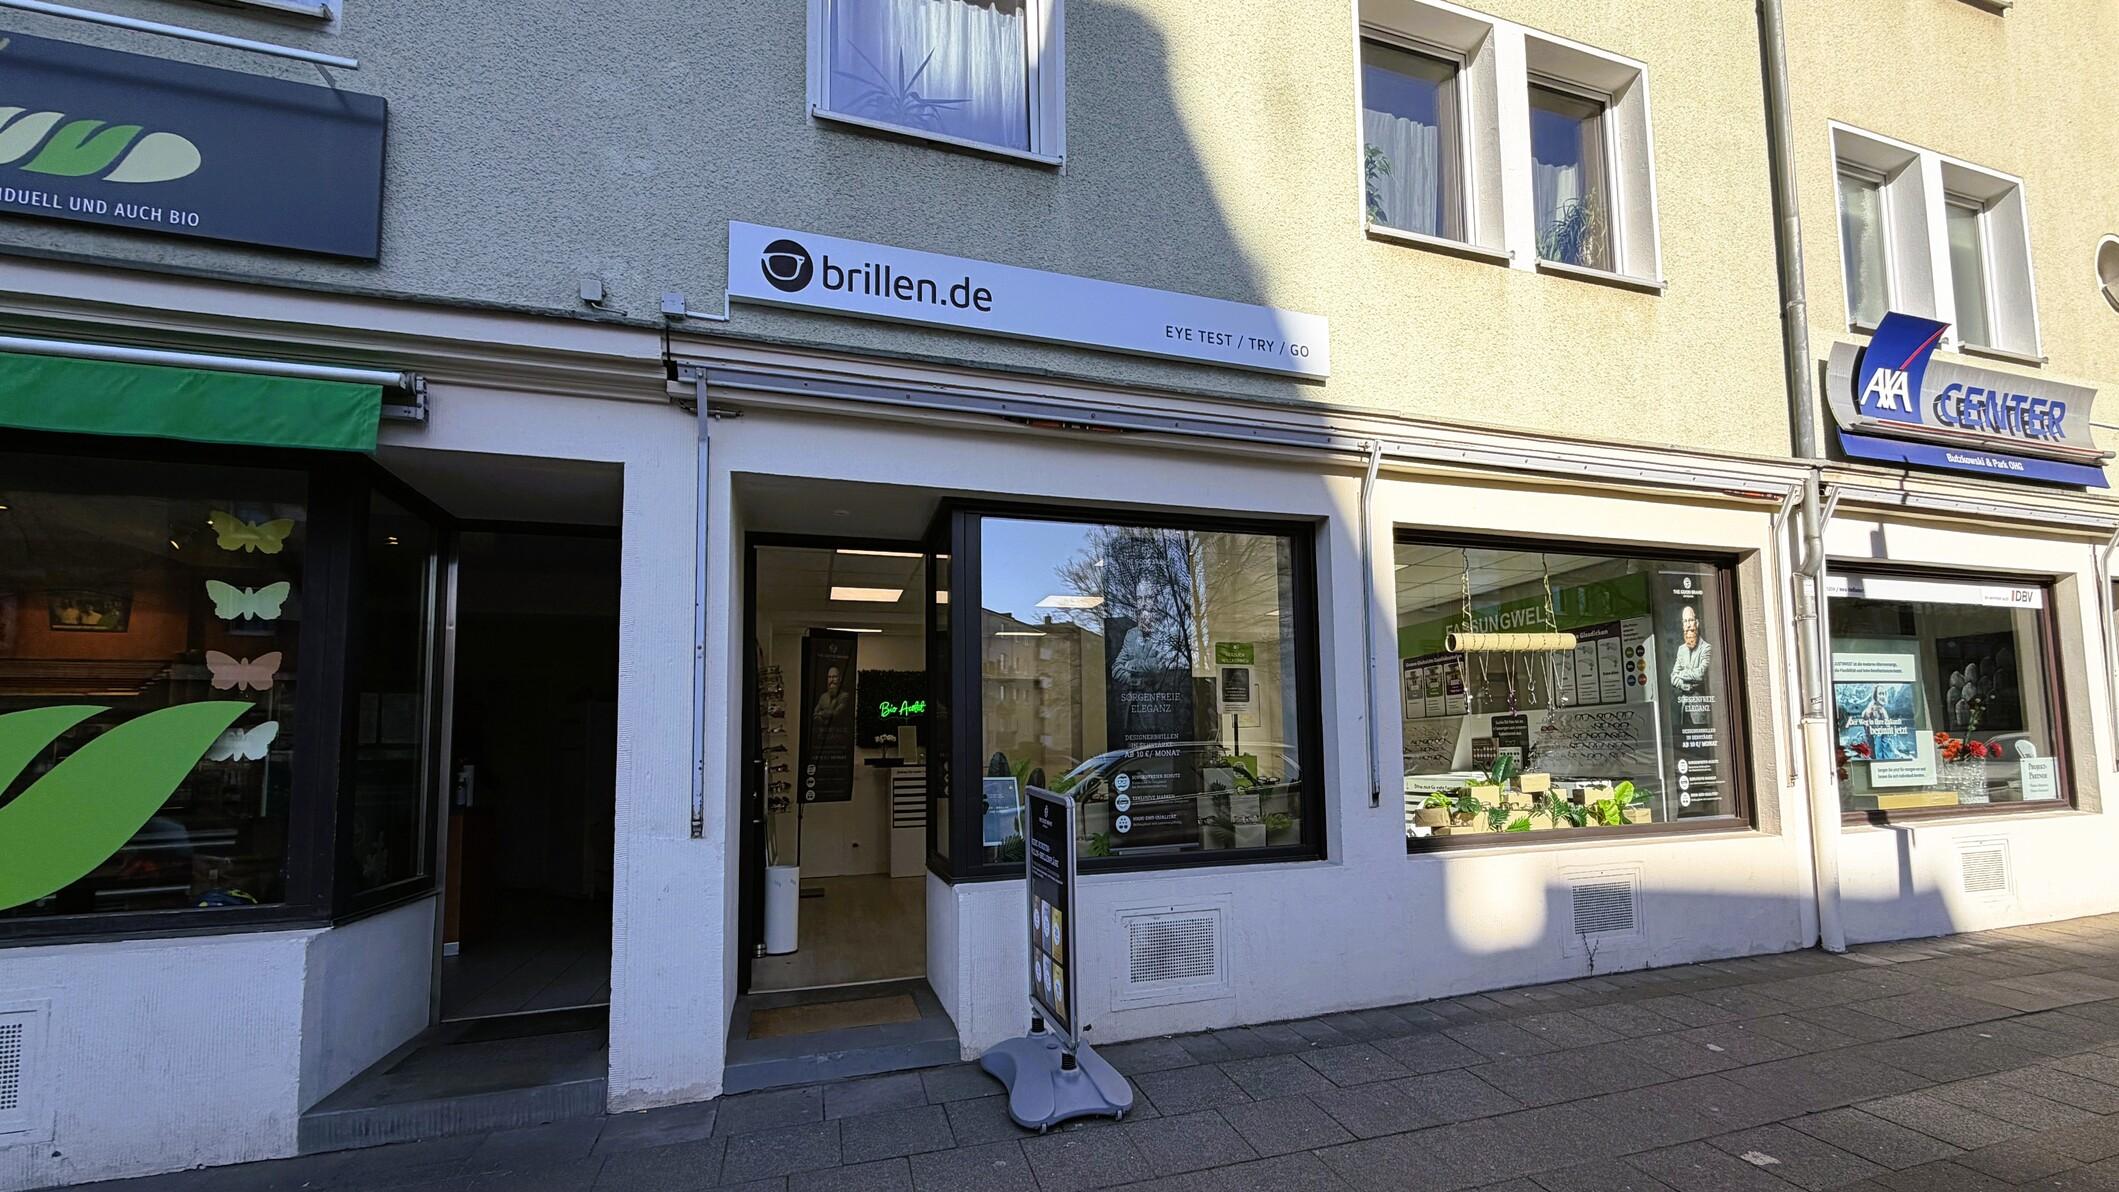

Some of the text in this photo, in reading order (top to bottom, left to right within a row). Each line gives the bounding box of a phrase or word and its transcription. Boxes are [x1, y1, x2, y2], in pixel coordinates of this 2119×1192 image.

[70, 196, 107, 214] UND
[114, 203, 161, 221] AUCH
[170, 210, 199, 226] BIO
[822, 255, 993, 312] brillen.de
[1166, 325, 1309, 358] EYE TEST / TRY / GO
[1861, 368, 1913, 414] AXA
[1941, 383, 2066, 439] CENTER
[1946, 453, 2024, 471] Butzkowski & Park OHG
[2015, 590, 2033, 603] DBV
[1121, 692, 1181, 702] SORGENFREIE
[879, 701, 898, 717] Bio
[1131, 704, 1171, 713] ELEGANZ
[1136, 750, 1143, 758] 10
